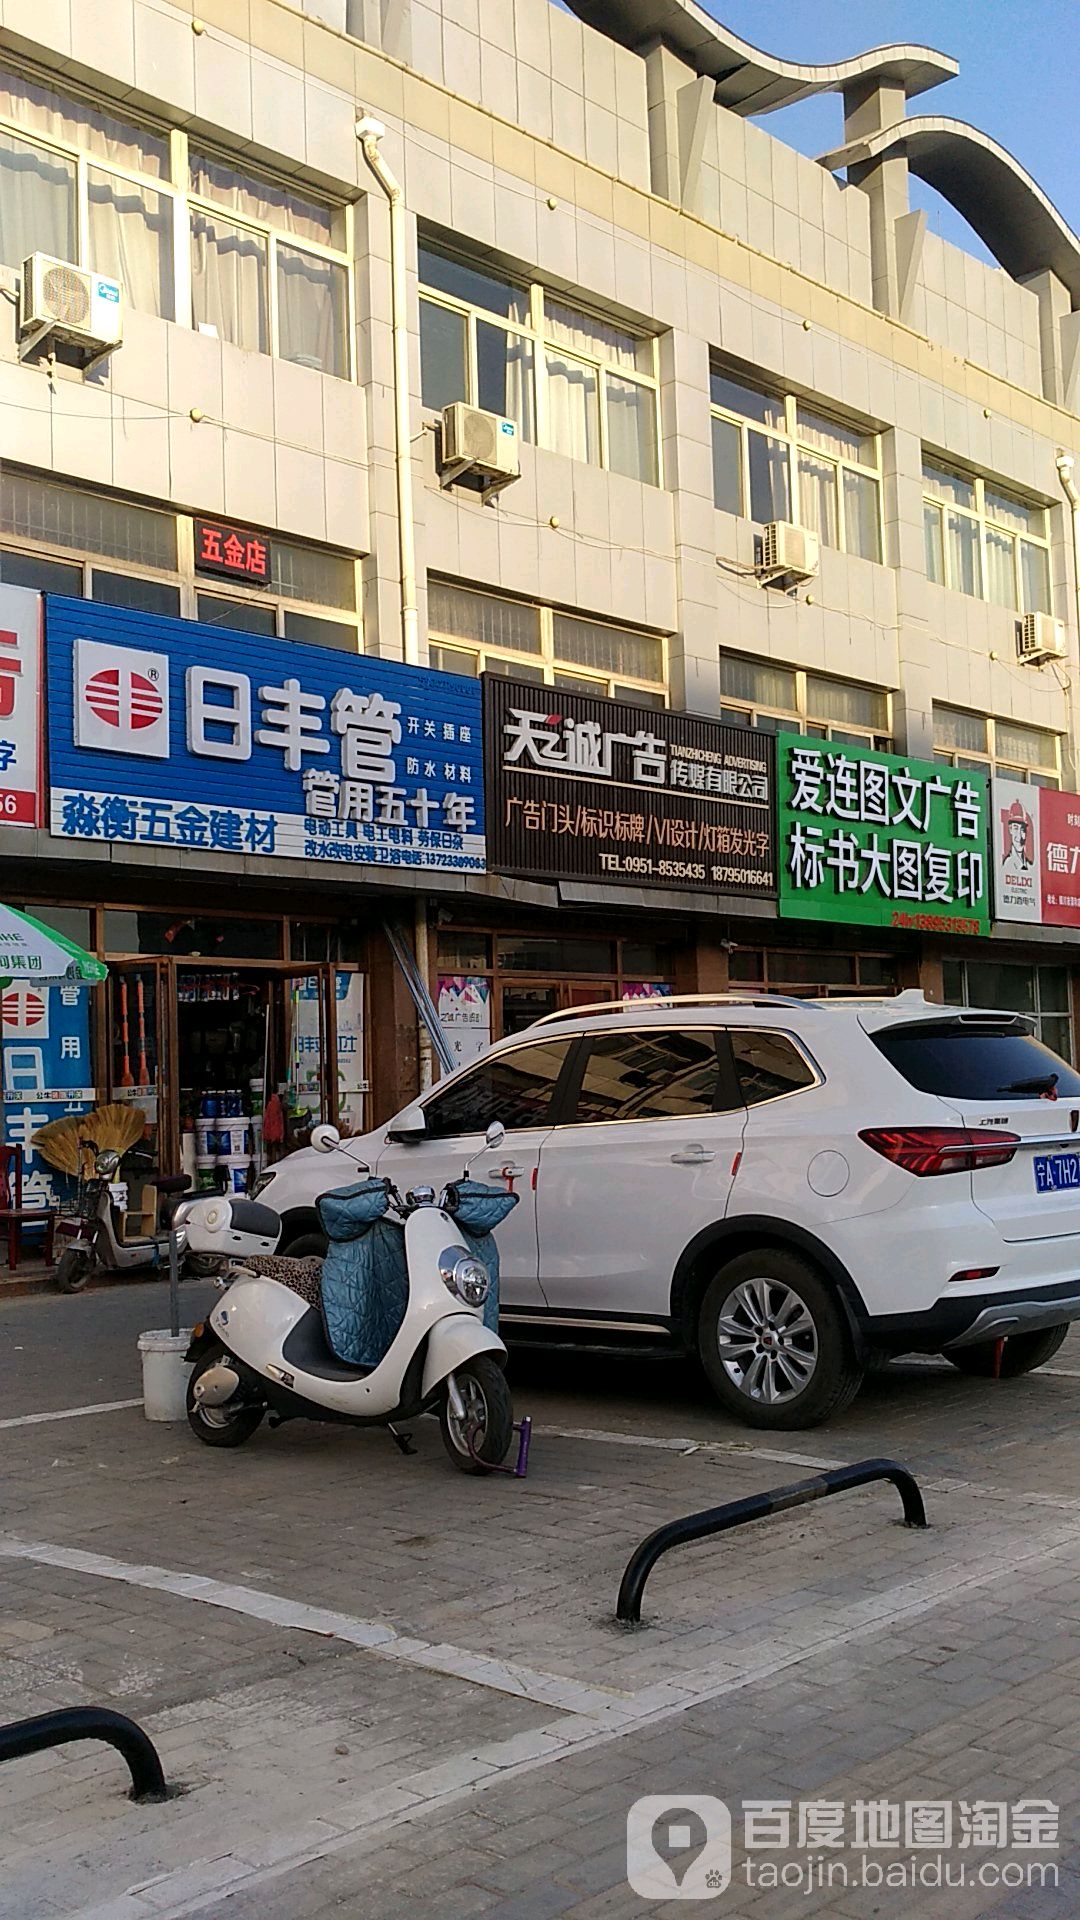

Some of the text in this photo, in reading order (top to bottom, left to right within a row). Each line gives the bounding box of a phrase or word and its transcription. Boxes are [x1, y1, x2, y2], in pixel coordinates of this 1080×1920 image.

[201, 528, 266, 575] 五金店
[185, 666, 402, 784] 日丰管
[407, 716, 471, 743] 开关插座
[407, 757, 471, 783] 防水材料
[669, 743, 768, 773] TIANZHICHENG ADVERTISING
[669, 758, 769, 800] 传媒有限公司
[790, 747, 981, 839] 爱连图文广告
[302, 768, 477, 833] 管用五十年
[304, 817, 358, 839] 电动工具
[710, 865, 774, 887] 18795016641
[790, 821, 983, 907] 标书大图复印
[1005, 875, 1033, 888] DELIXI
